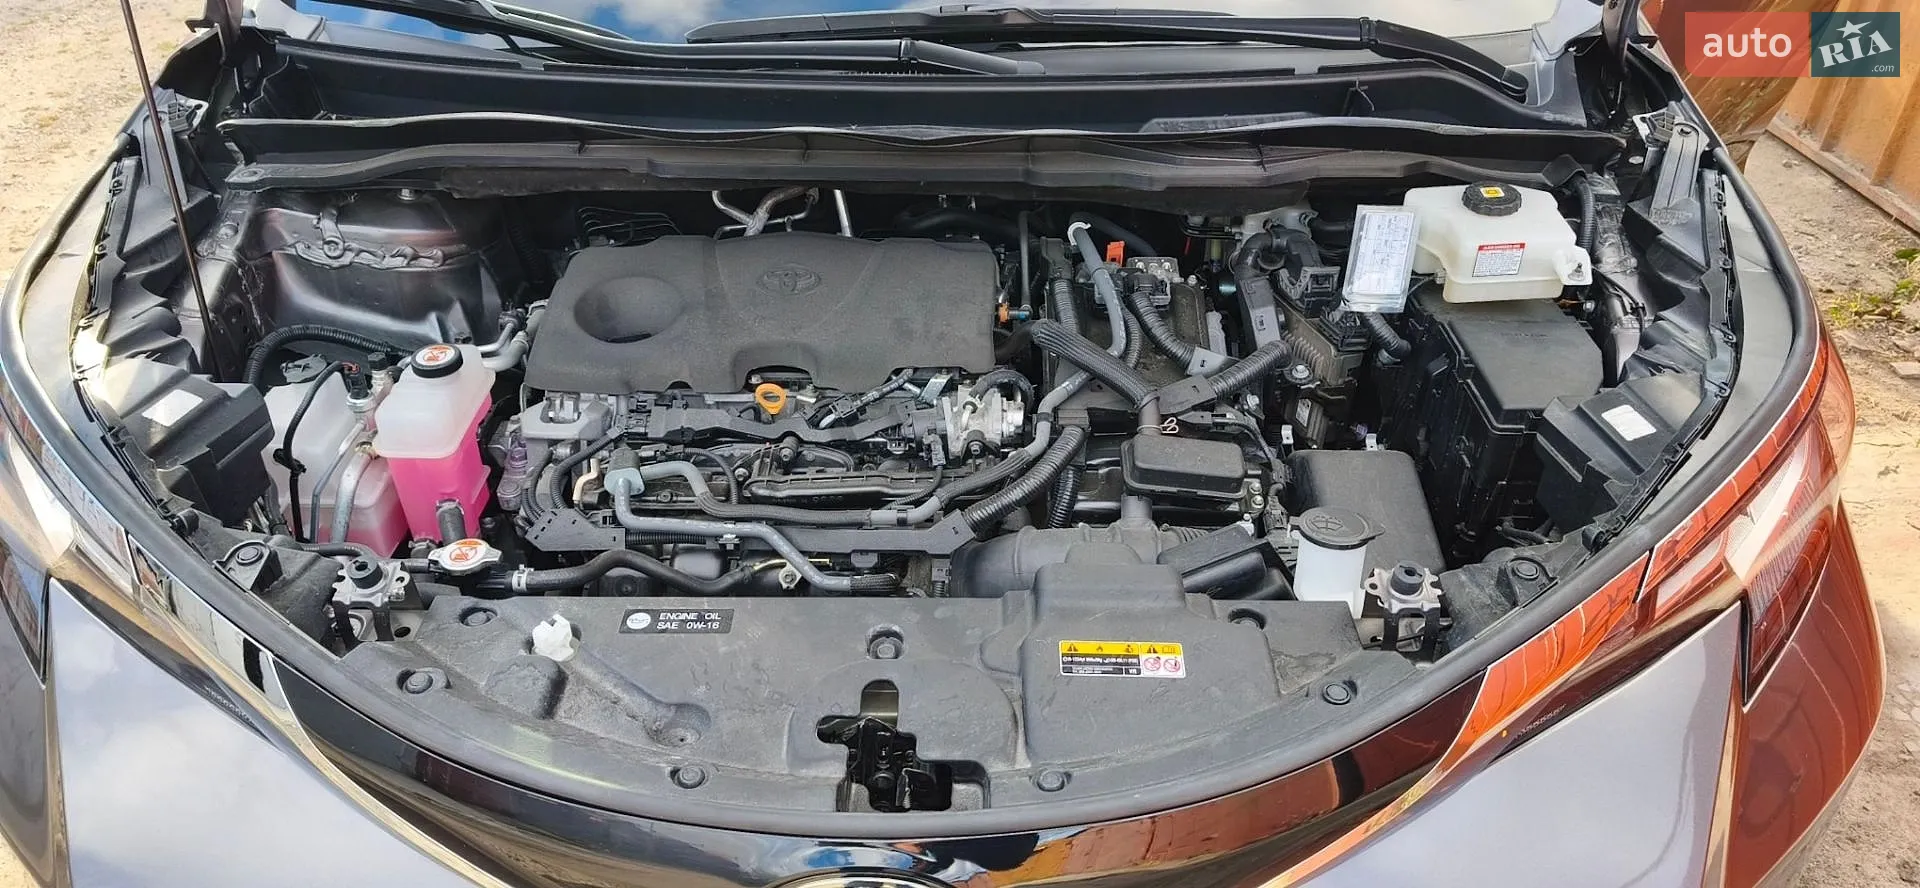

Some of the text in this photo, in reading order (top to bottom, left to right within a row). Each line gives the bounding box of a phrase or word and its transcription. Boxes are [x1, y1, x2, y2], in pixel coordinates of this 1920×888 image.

[659, 612, 698, 620] ENGINE
[704, 612, 722, 620] OIL
[656, 621, 679, 629] SAE
